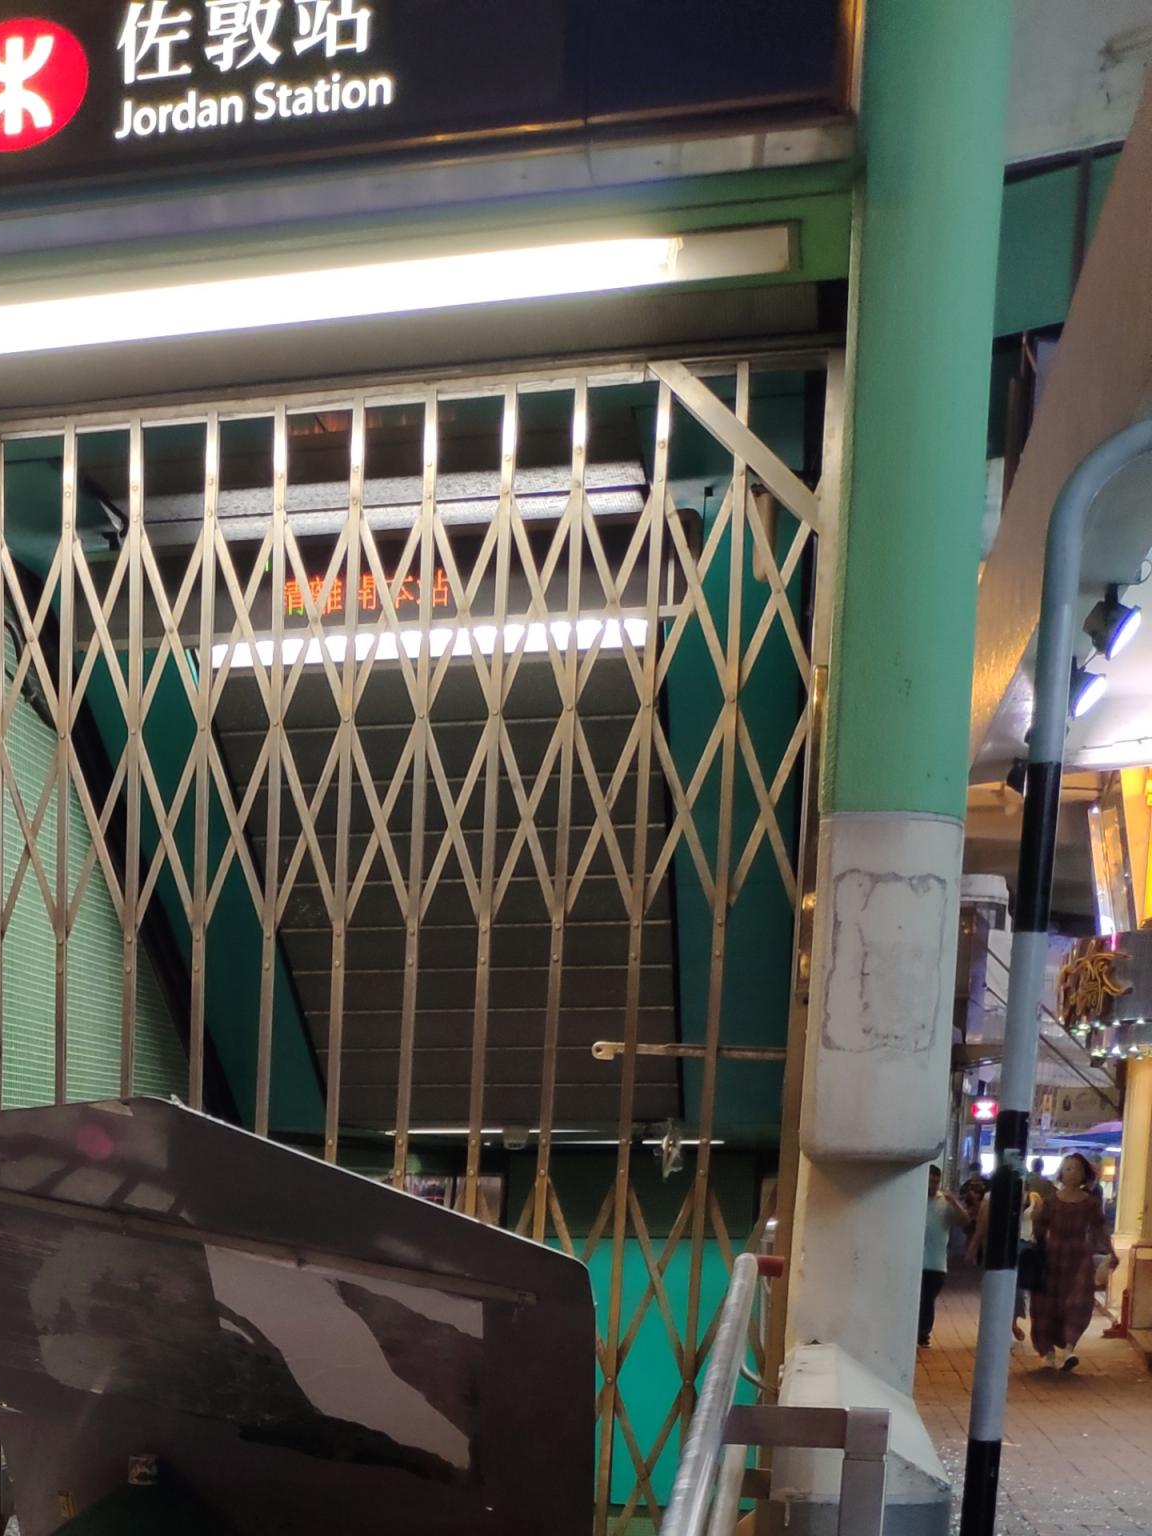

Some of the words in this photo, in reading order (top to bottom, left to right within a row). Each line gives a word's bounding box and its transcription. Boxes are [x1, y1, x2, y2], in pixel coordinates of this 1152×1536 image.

[117, 0, 372, 85] 佐敦站
[114, 87, 244, 140] Jordan
[253, 72, 394, 122] Station
